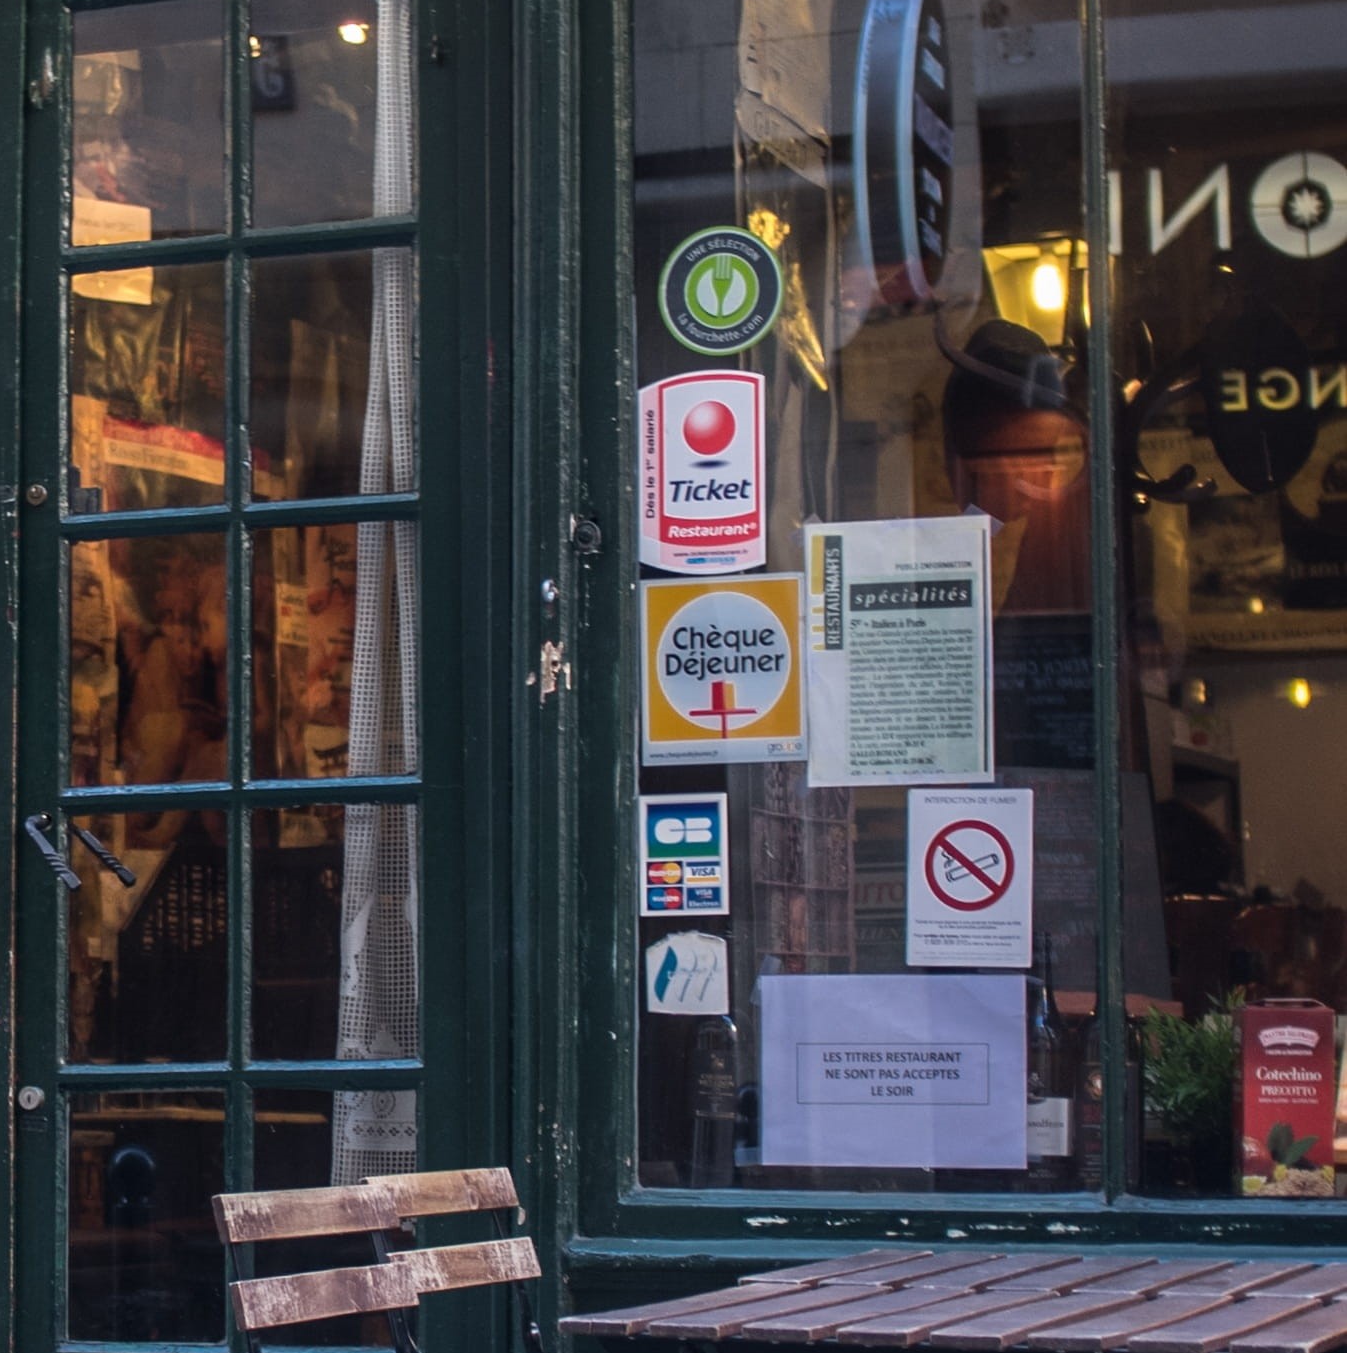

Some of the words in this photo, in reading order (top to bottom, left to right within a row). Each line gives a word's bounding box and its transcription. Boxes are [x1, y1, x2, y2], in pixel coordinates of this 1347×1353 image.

[686, 244, 707, 262] UNE
[707, 237, 761, 262] SÉLECTION
[669, 479, 752, 503] Ticket
[826, 547, 841, 645] RESTAURANTS
[854, 586, 969, 608] spécialités
[673, 624, 775, 653] Chèque
[665, 651, 785, 681] Déjeuner
[924, 796, 976, 804] INTERDICTION
[654, 816, 713, 844] CB
[691, 867, 716, 877] VISA
[823, 1052, 842, 1063] LES
[845, 1052, 883, 1063] TITRES
[886, 1051, 962, 1063] RESTAURANT
[825, 1069, 841, 1079] NE
[844, 1069, 875, 1079] SONT
[879, 1069, 900, 1079] PAS
[903, 1069, 960, 1080] ACCEPTES
[1256, 1066, 1322, 1082] Cotechino
[871, 1086, 884, 1096] LE
[886, 1086, 913, 1096] SOIR
[1261, 1085, 1317, 1096] PRECOTTO
